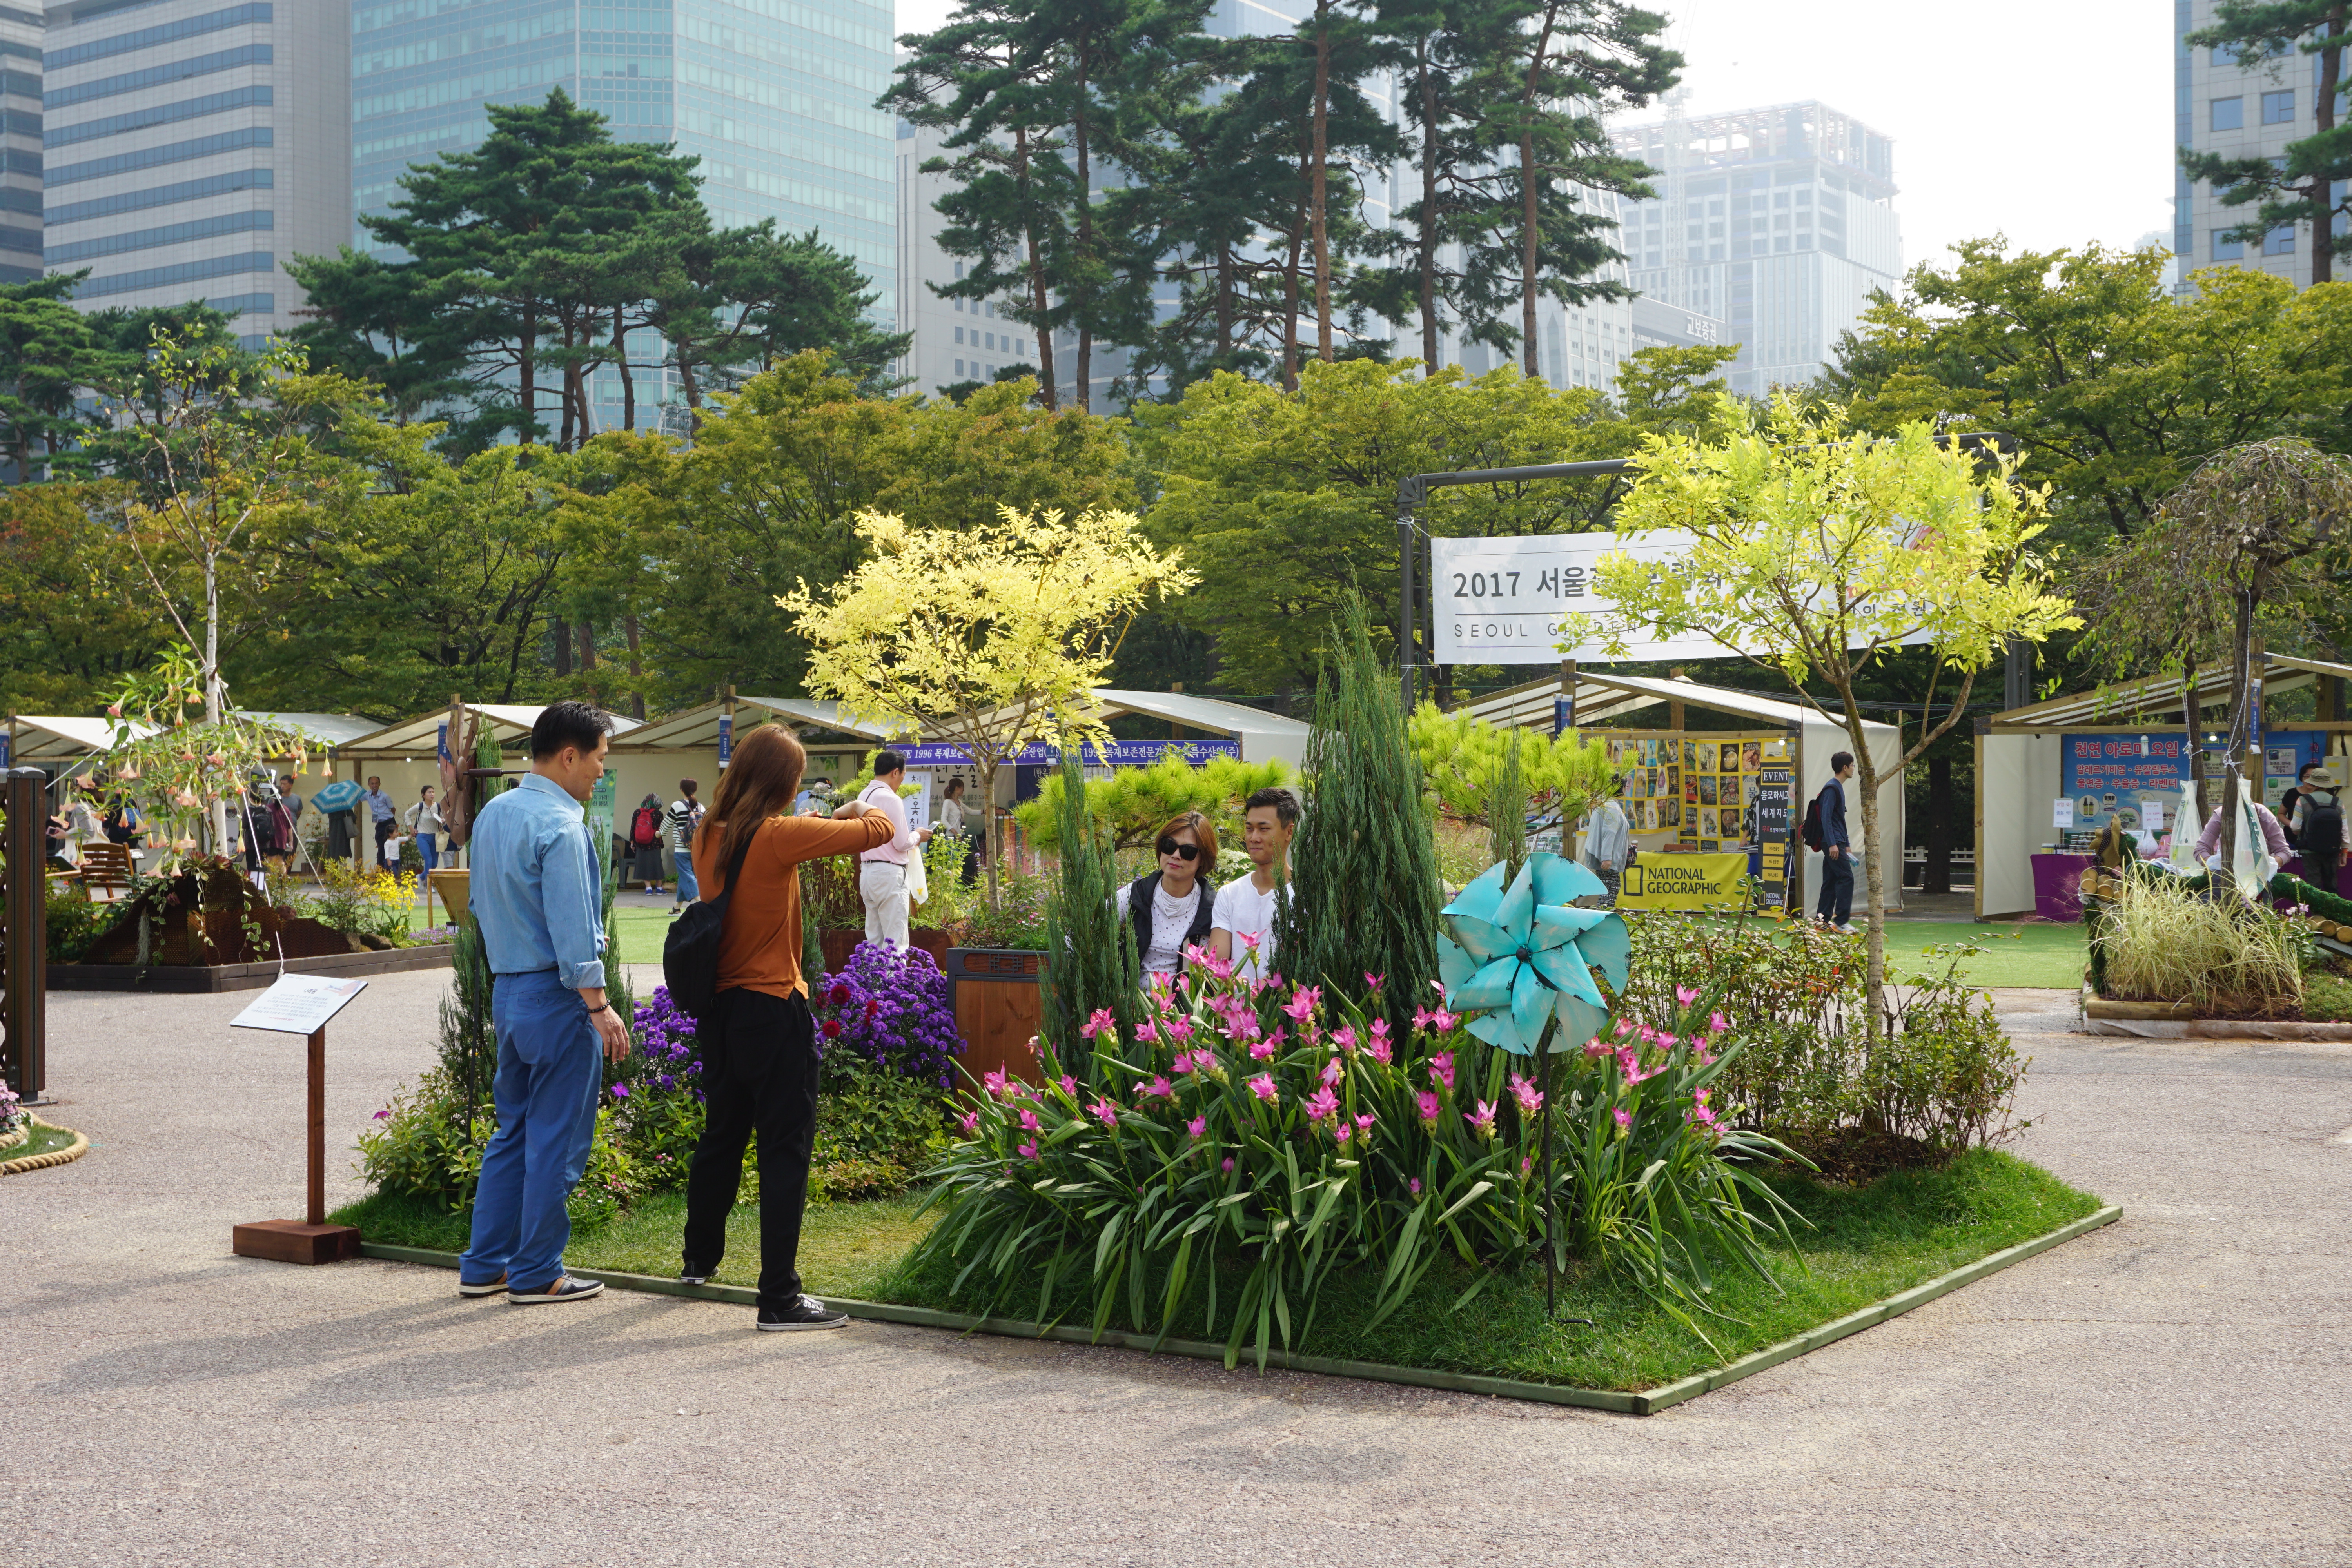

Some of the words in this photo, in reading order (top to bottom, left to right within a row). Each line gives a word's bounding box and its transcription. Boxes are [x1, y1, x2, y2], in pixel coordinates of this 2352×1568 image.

[1686, 316, 1716, 343] 교보증권
[1453, 572, 1520, 597] 2017
[1455, 624, 1528, 637] SEOUL
[914, 749, 933, 758] 1996
[1084, 748, 1103, 757] 199
[2075, 741, 2101, 758] 천연
[2150, 741, 2178, 758] 오일
[2076, 765, 2126, 775] 알레르기비염
[2134, 765, 2178, 775] 유칼립투스
[1763, 771, 1789, 781] EVENT
[2076, 778, 2103, 789] 불면증
[2111, 778, 2140, 789] 우울증
[2149, 778, 2178, 789] 라벤더
[1760, 790, 1788, 800] 응모하시고
[1761, 808, 1787, 818] 세계지도
[1648, 867, 1706, 880] NATIONAL
[1647, 882, 1722, 895] GEOGRAPHIC
